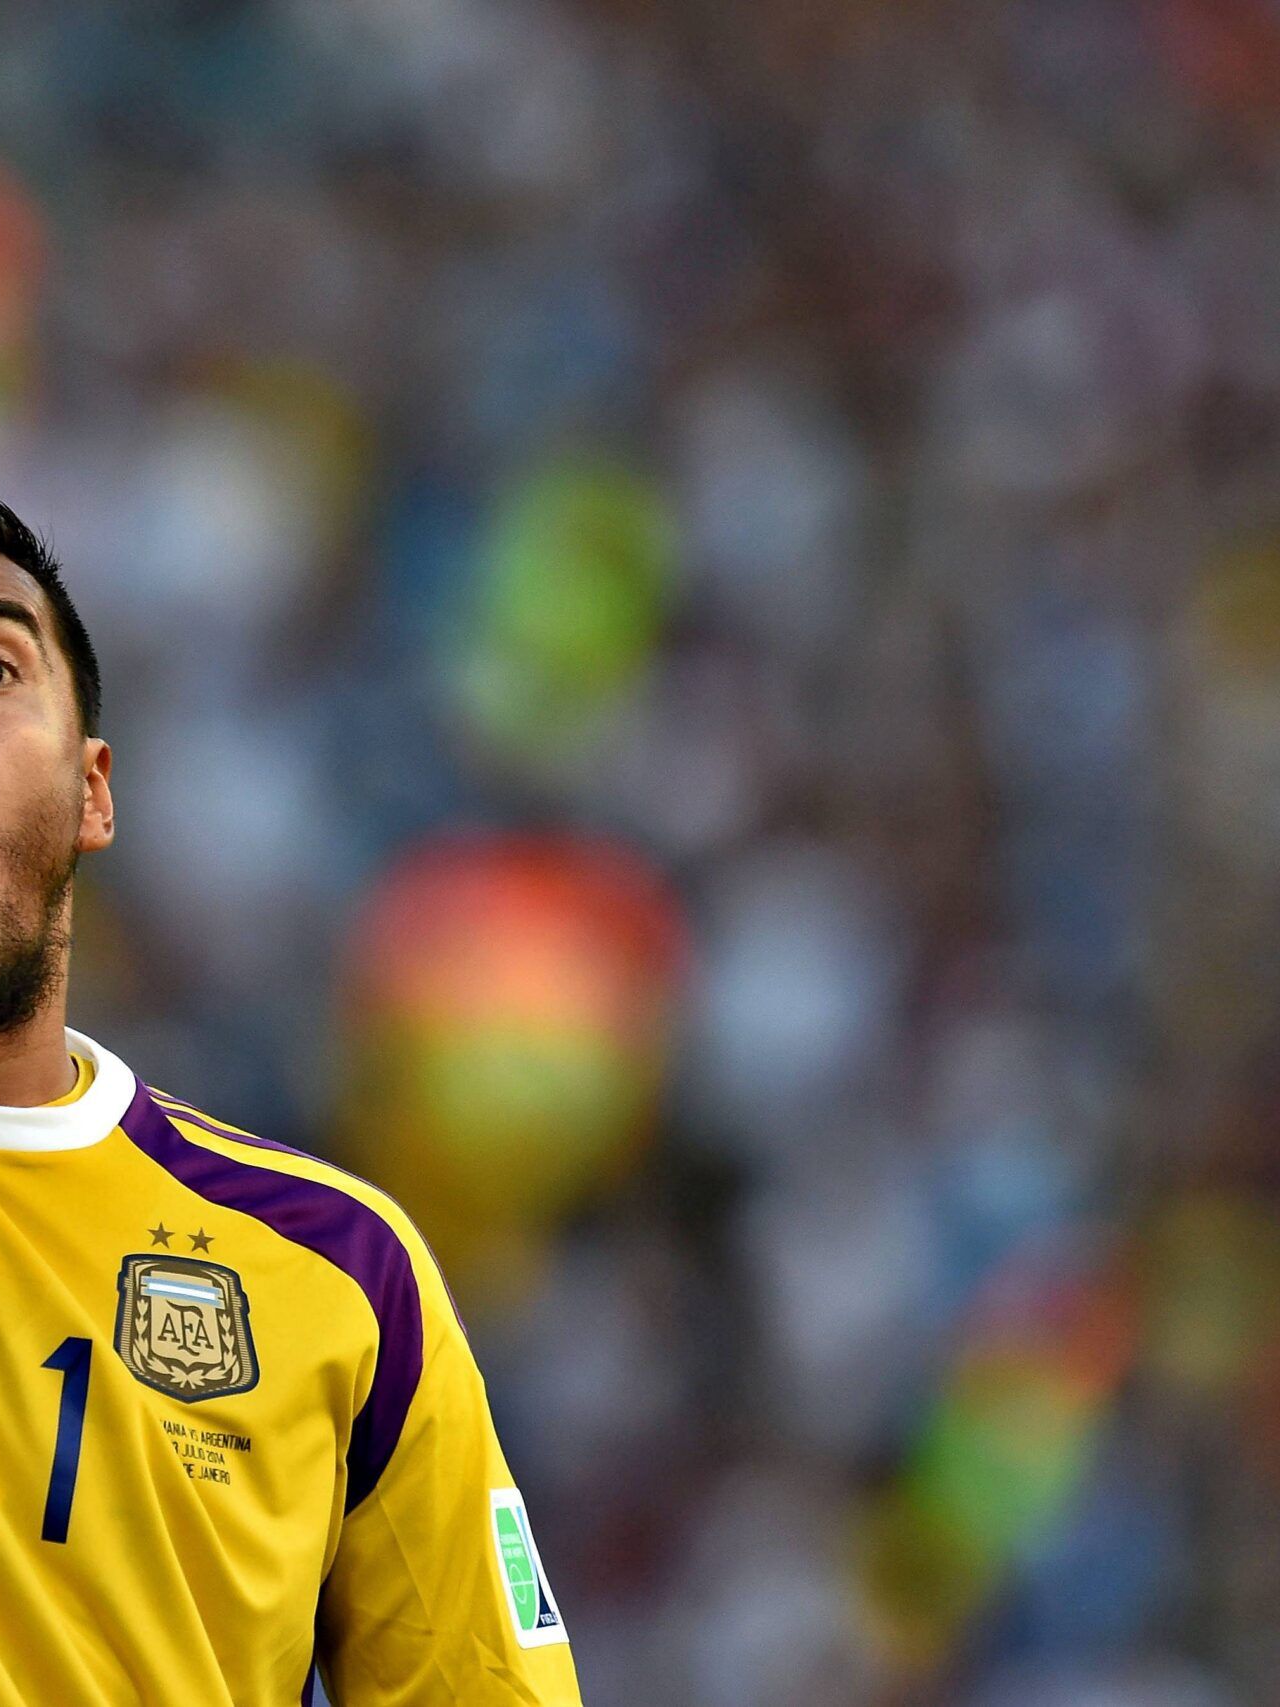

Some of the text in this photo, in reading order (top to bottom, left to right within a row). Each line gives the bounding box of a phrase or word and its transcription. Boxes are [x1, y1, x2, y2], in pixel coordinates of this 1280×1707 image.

[157, 1300, 215, 1356] AFA
[40, 1336, 93, 1544] 1
[200, 1431, 251, 1453] ARGENTINA
[198, 1466, 230, 1485] JANEIRO
